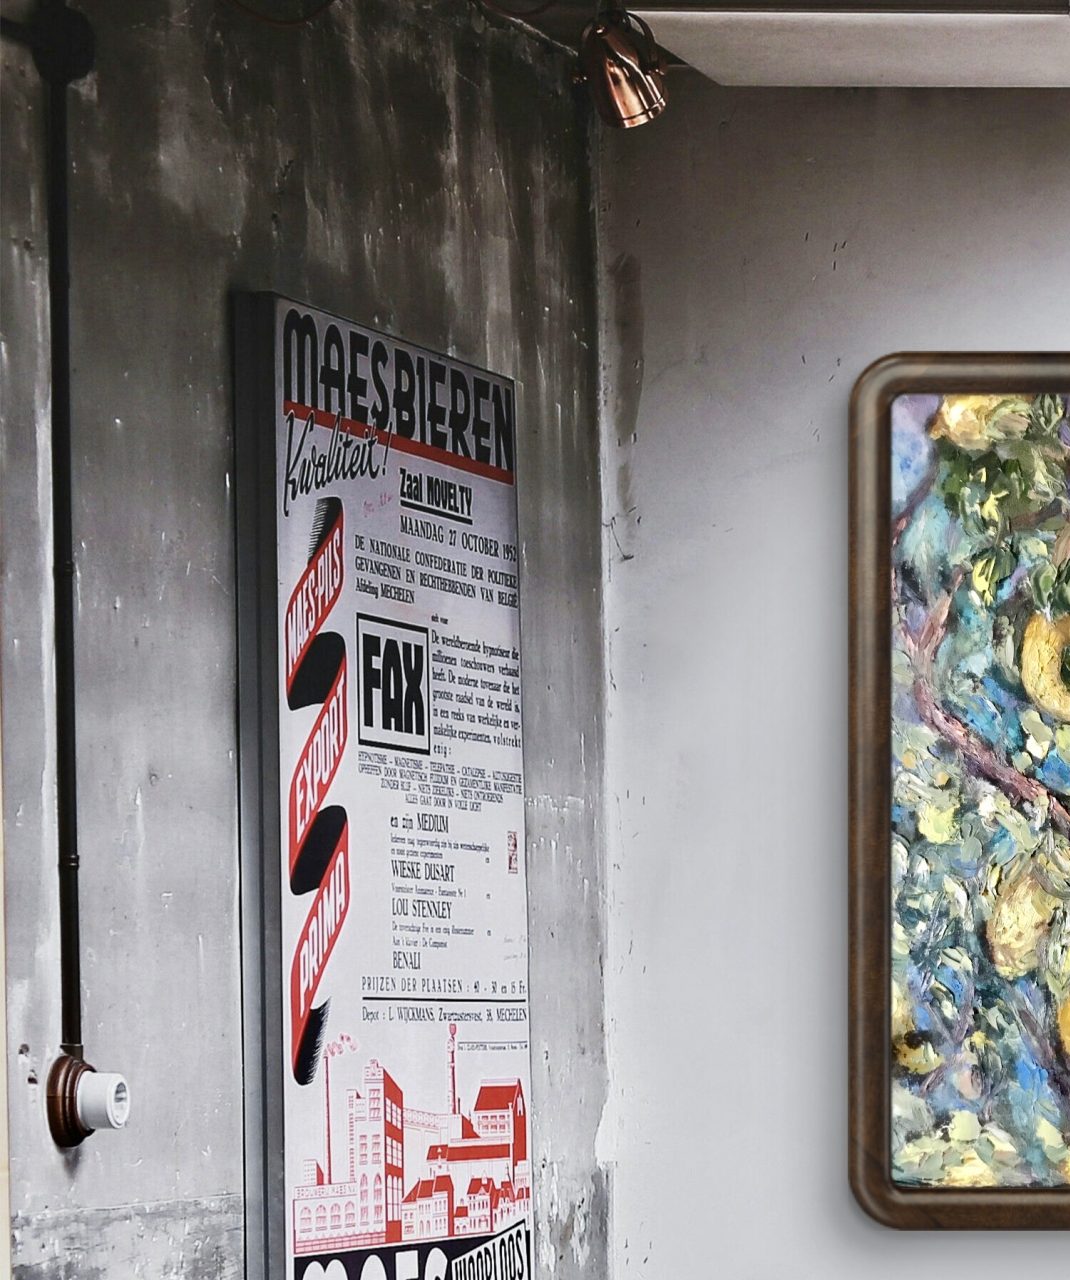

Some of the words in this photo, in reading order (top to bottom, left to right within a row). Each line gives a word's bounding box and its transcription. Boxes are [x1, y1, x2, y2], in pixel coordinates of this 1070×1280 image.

[400, 468, 423, 502] Zaal
[427, 475, 473, 516] NOVELTY
[400, 515, 444, 543] MAANDAG
[449, 529, 457, 547] 27
[462, 532, 499, 558] OCTOBER
[503, 544, 517, 562] 1952
[355, 534, 365, 551] DE
[370, 538, 411, 563] NATIONALE
[415, 551, 467, 577] CONFEDERATIE
[472, 565, 484, 581] DER
[488, 569, 517, 589] POLITIEKE
[355, 555, 401, 580] GEVANGENEN
[406, 568, 415, 583] EN
[420, 572, 476, 598] RECHTHEBBENDEN
[480, 587, 494, 602] VAN
[287, 527, 340, 677] MAES-PILS
[381, 583, 415, 604] MECHELEN
[432, 629, 440, 645] De
[511, 646, 519, 661] die
[363, 633, 425, 736] FAX
[448, 669, 456, 684] De
[475, 697, 485, 708] van
[487, 695, 494, 709] de
[440, 708, 449, 719] een
[451, 707, 464, 721] reeks
[466, 713, 475, 724] van
[503, 719, 509, 729] en
[494, 732, 521, 748] volstrekt
[295, 671, 345, 843] EXPORT
[384, 766, 397, 778] DOOR
[390, 816, 398, 828] en
[416, 812, 449, 834] MEDIUM
[391, 859, 421, 880] WIESKE
[424, 862, 455, 883] DUSART
[392, 897, 408, 917] LOU
[412, 898, 453, 920] STENNLEY
[300, 851, 346, 1013] PRIMA
[393, 950, 421, 970] BENALI
[362, 976, 396, 993] PRIJZEN
[401, 977, 417, 992] DER
[421, 977, 463, 993] PLAATSEN
[362, 1006, 379, 1023] Depot
[496, 1007, 527, 1022] MECHELEN
